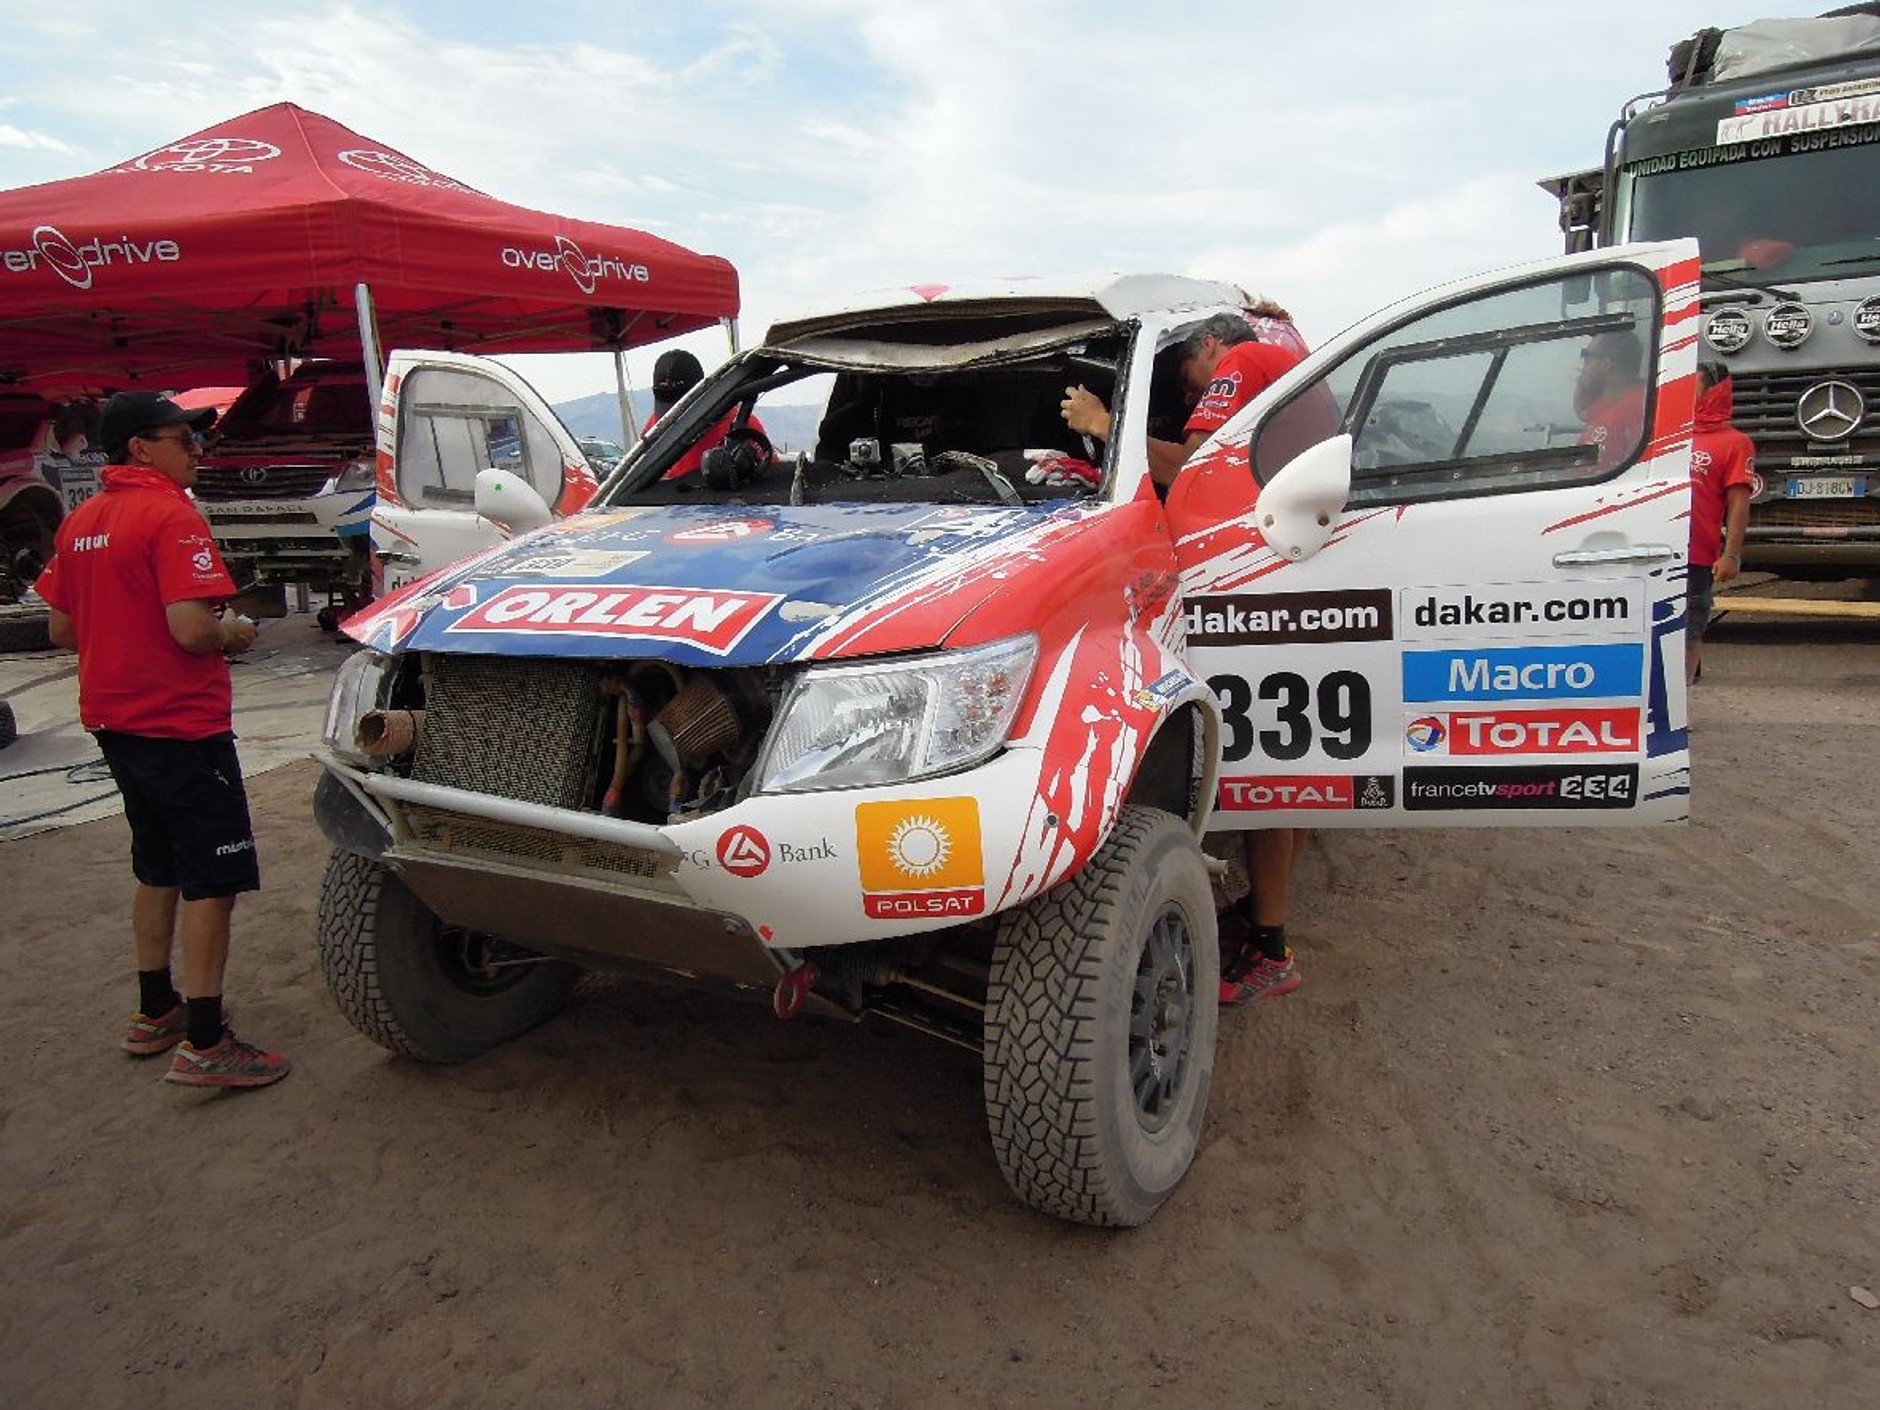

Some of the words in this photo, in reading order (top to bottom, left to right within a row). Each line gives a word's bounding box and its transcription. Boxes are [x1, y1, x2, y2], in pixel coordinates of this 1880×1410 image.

[1630, 157, 1676, 179] UNIDAD
[1679, 145, 1747, 168] EQUIPADA
[1751, 139, 1782, 157] CON
[1711, 324, 1746, 335] Hella
[1771, 320, 1806, 331] Hella
[483, 591, 749, 633] ORLEN
[1184, 604, 1379, 635] dakar.com
[1415, 595, 1629, 627] dakar.com
[1448, 658, 1596, 692] Macro
[1205, 669, 1372, 762] 339
[1456, 716, 1632, 748] TOTAL
[1223, 782, 1348, 804] TOTAL
[778, 837, 838, 863] Bank
[876, 896, 974, 914] POLSAT
